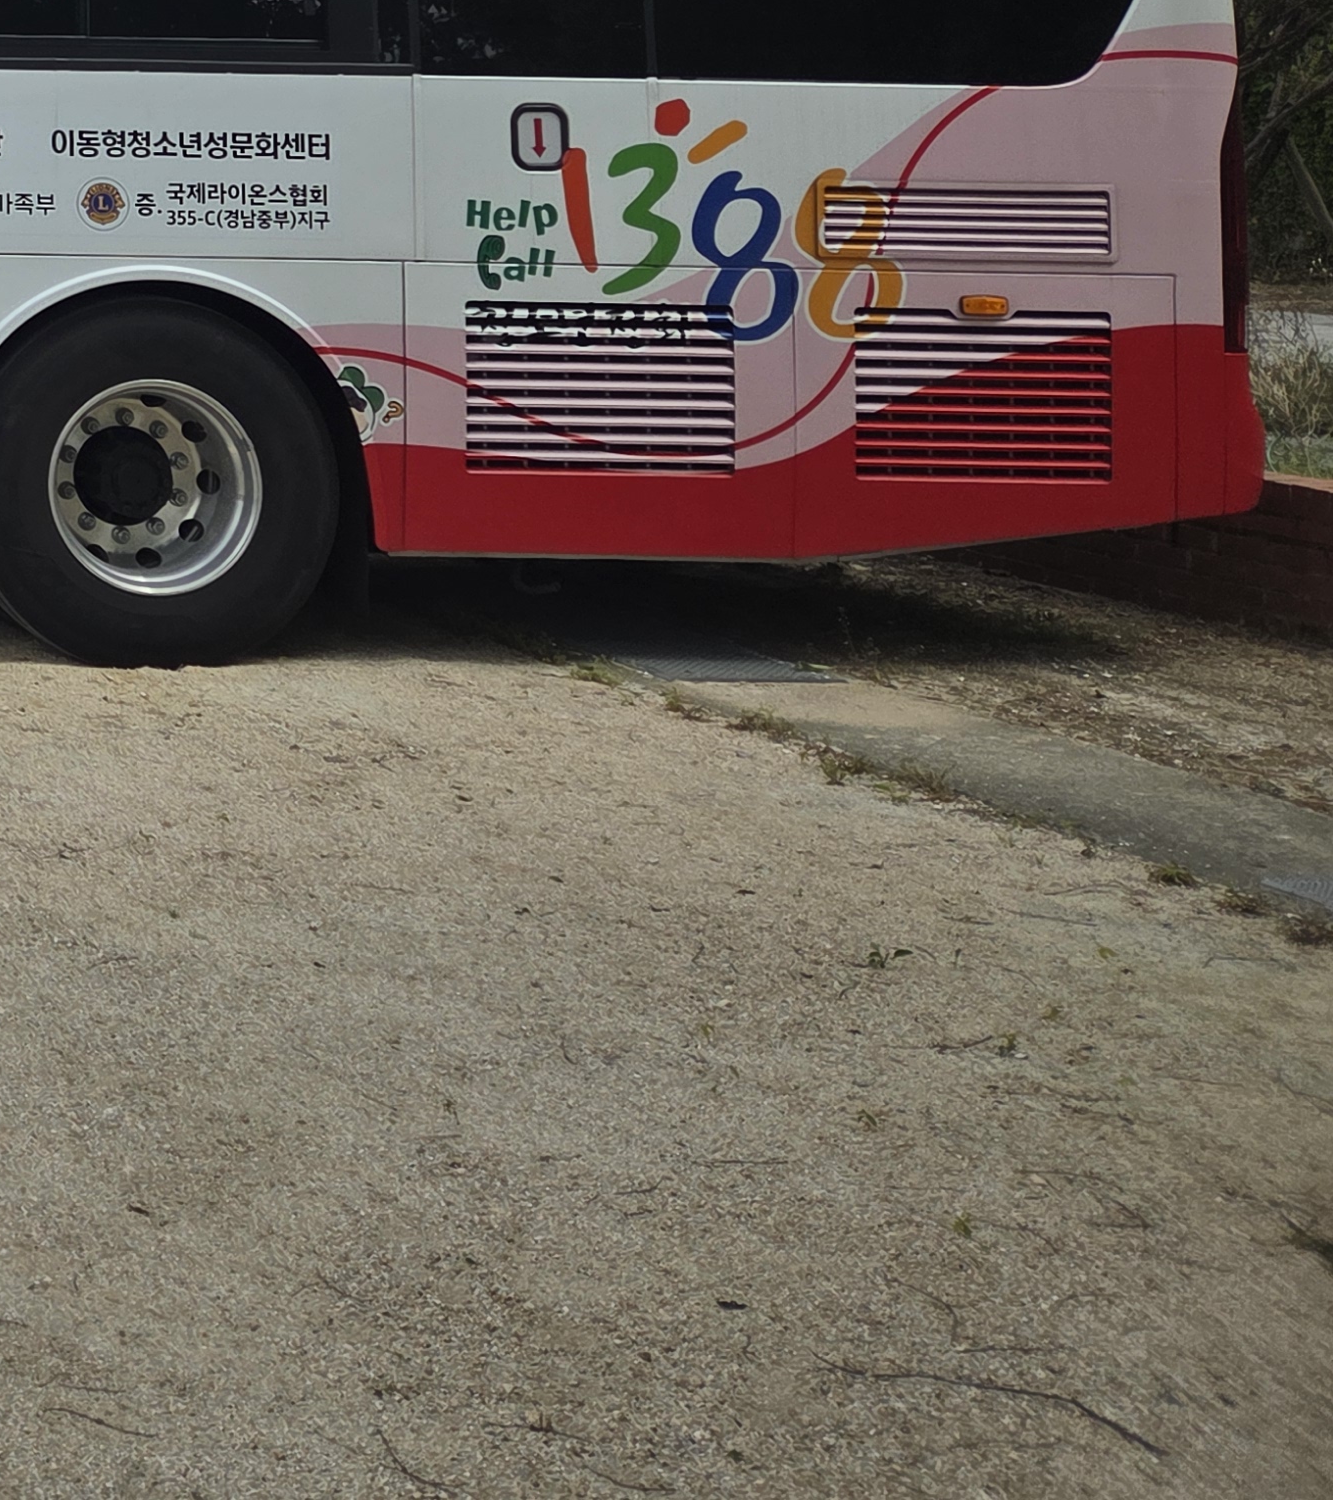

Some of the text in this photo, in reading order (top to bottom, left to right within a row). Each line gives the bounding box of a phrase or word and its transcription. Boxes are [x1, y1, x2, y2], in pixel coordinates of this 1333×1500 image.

[51, 129, 331, 161] 이동형청소년성문화센터
[165, 182, 328, 207] 국제라이온스협회
[165, 208, 331, 231] 355-C(경남중부)지구
[465, 199, 558, 236] Help
